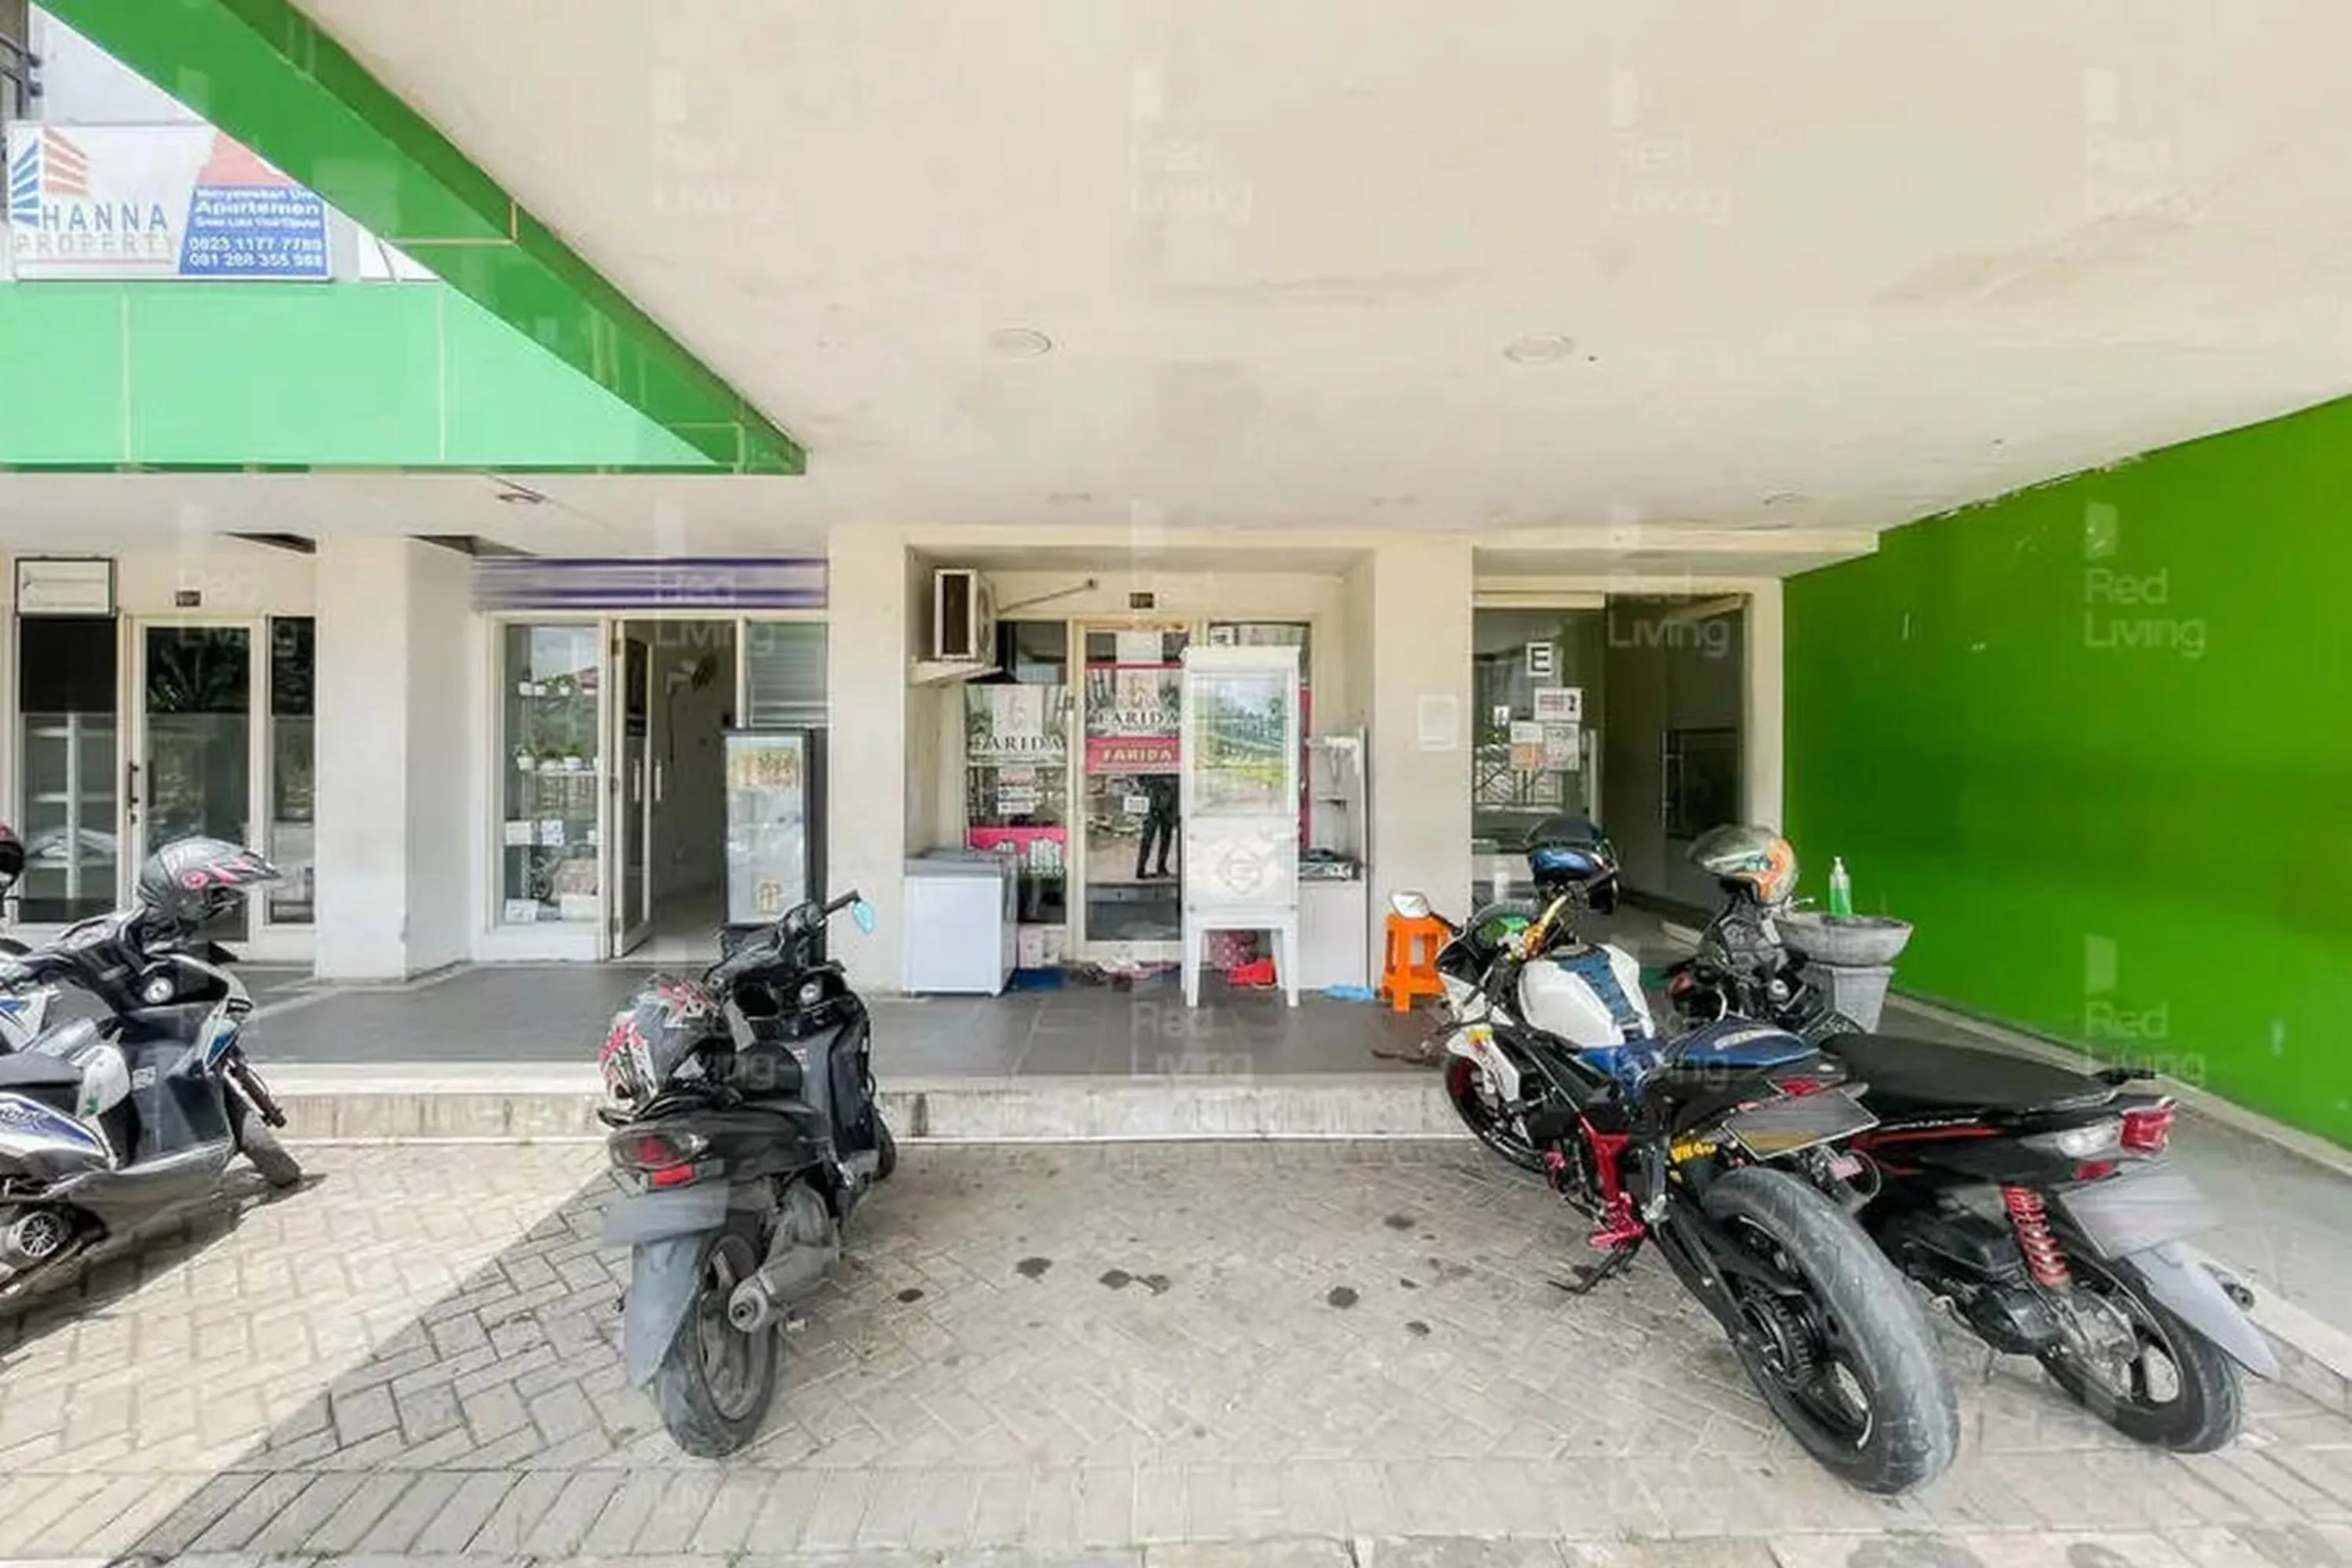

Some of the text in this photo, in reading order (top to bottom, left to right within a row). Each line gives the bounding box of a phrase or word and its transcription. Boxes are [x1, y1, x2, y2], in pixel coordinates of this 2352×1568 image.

[42, 203, 168, 231] HANNA
[195, 201, 320, 216] Apartemen
[1531, 647, 1552, 672] E
